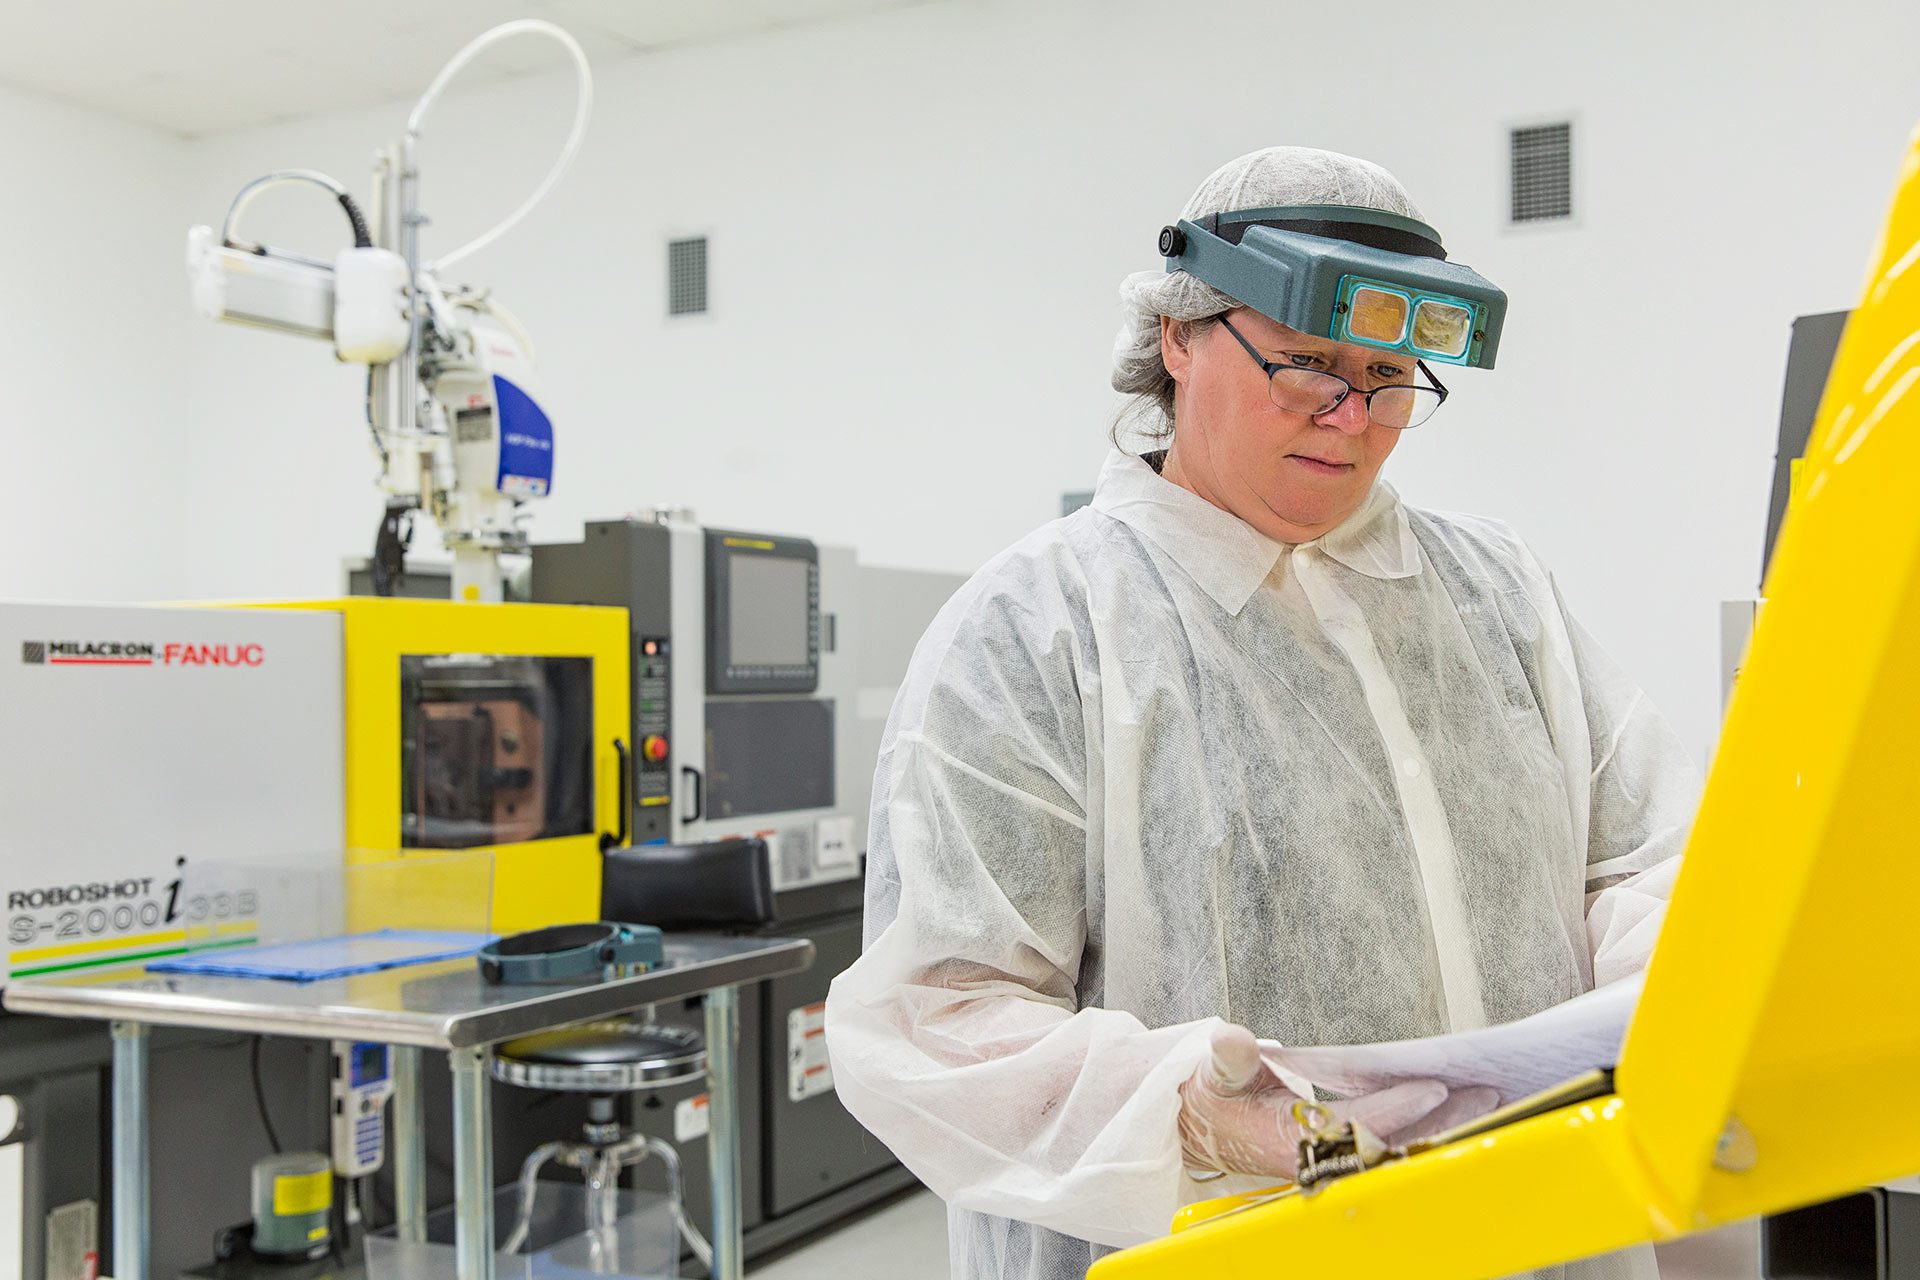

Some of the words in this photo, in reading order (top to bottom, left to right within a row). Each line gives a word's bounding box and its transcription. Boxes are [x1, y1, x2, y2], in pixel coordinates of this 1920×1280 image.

[49, 641, 153, 656] MILACRON
[163, 643, 264, 667] FANUC
[8, 877, 153, 911] ROBOSHOT
